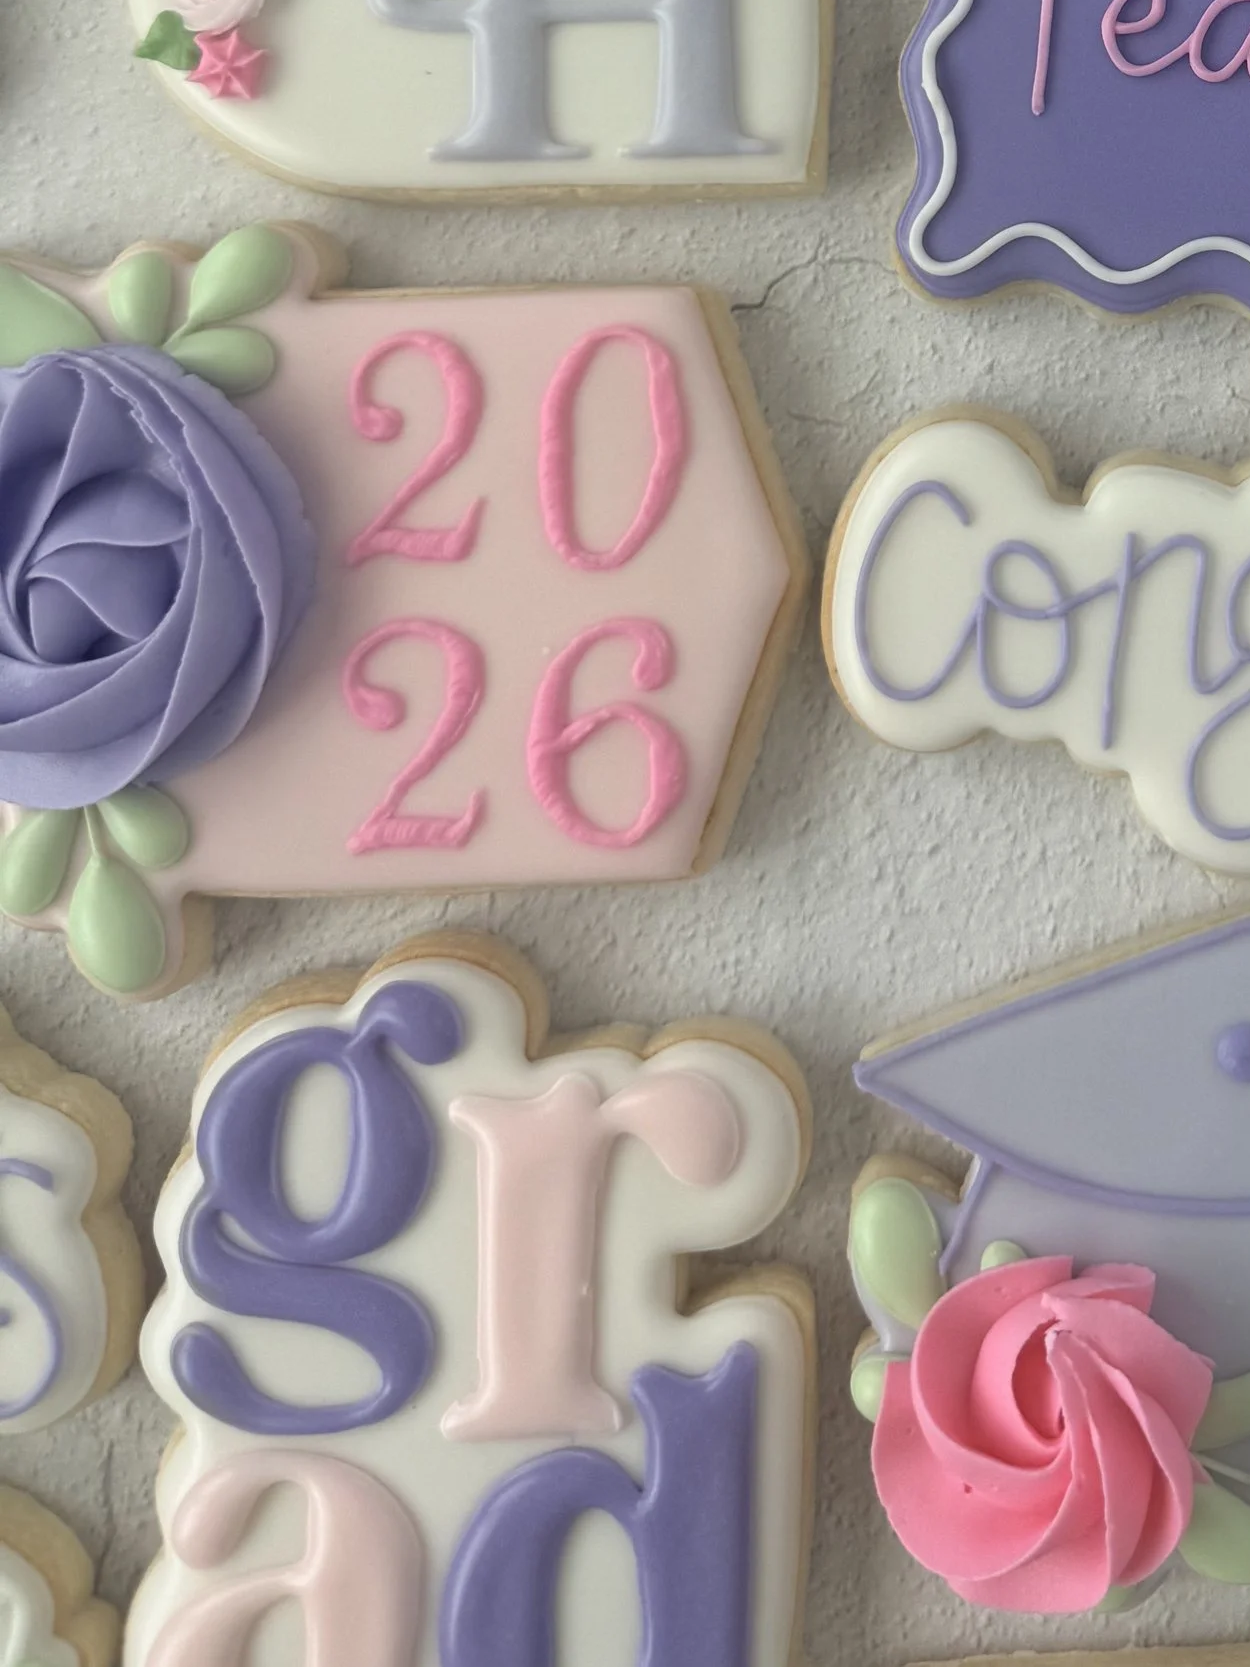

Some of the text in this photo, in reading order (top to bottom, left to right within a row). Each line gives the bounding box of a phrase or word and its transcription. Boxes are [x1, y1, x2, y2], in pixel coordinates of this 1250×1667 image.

[348, 324, 690, 572] 20
[342, 616, 688, 856] 26
[170, 979, 742, 1442] gr
